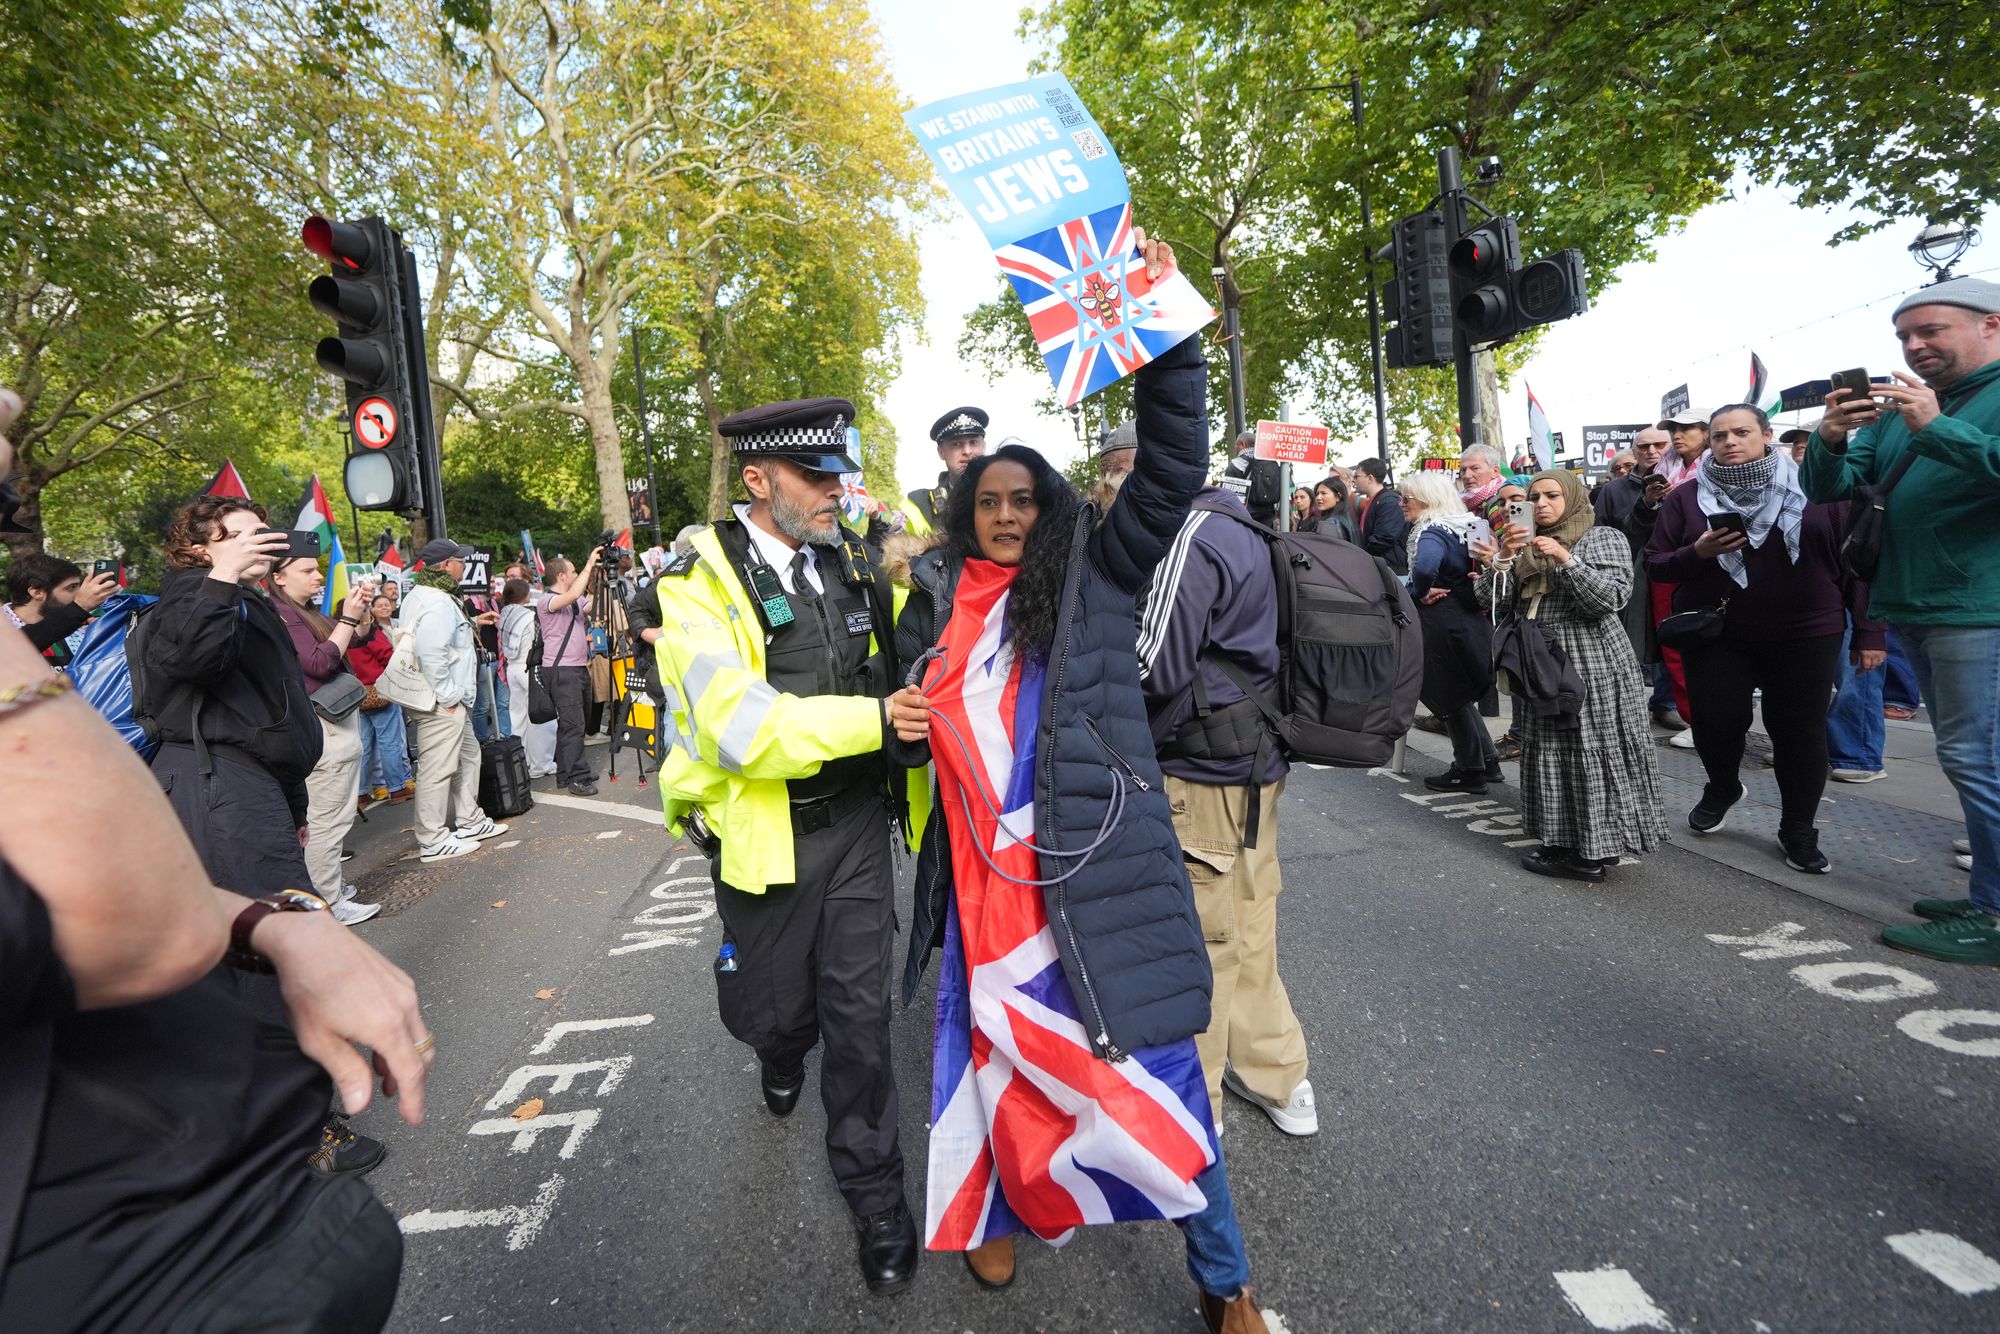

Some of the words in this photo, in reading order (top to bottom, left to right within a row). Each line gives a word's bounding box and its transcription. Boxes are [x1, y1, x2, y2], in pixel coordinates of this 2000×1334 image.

[1055, 103, 1075, 114] OUR
[919, 117, 948, 140] WE
[950, 102, 1004, 128] STAND
[1002, 93, 1040, 117] WITH
[1059, 113, 1085, 126] FIGHT
[937, 116, 1060, 174] BRITAIN'S
[974, 148, 1089, 224] JEWS
[1275, 426, 1312, 436] CAUTION
[1586, 431, 1609, 442] Stop
[1610, 430, 1637, 440] Starvi
[1260, 432, 1325, 446] CONSTRUCTION
[1275, 442, 1308, 452] ACCESS
[1276, 450, 1305, 459] AHEAD
[1425, 459, 1443, 469] END
[1445, 459, 1461, 469] THE
[459, 562, 488, 585] ZA
[1704, 921, 2000, 1058] OOK
[398, 1014, 655, 1251] LEFT
